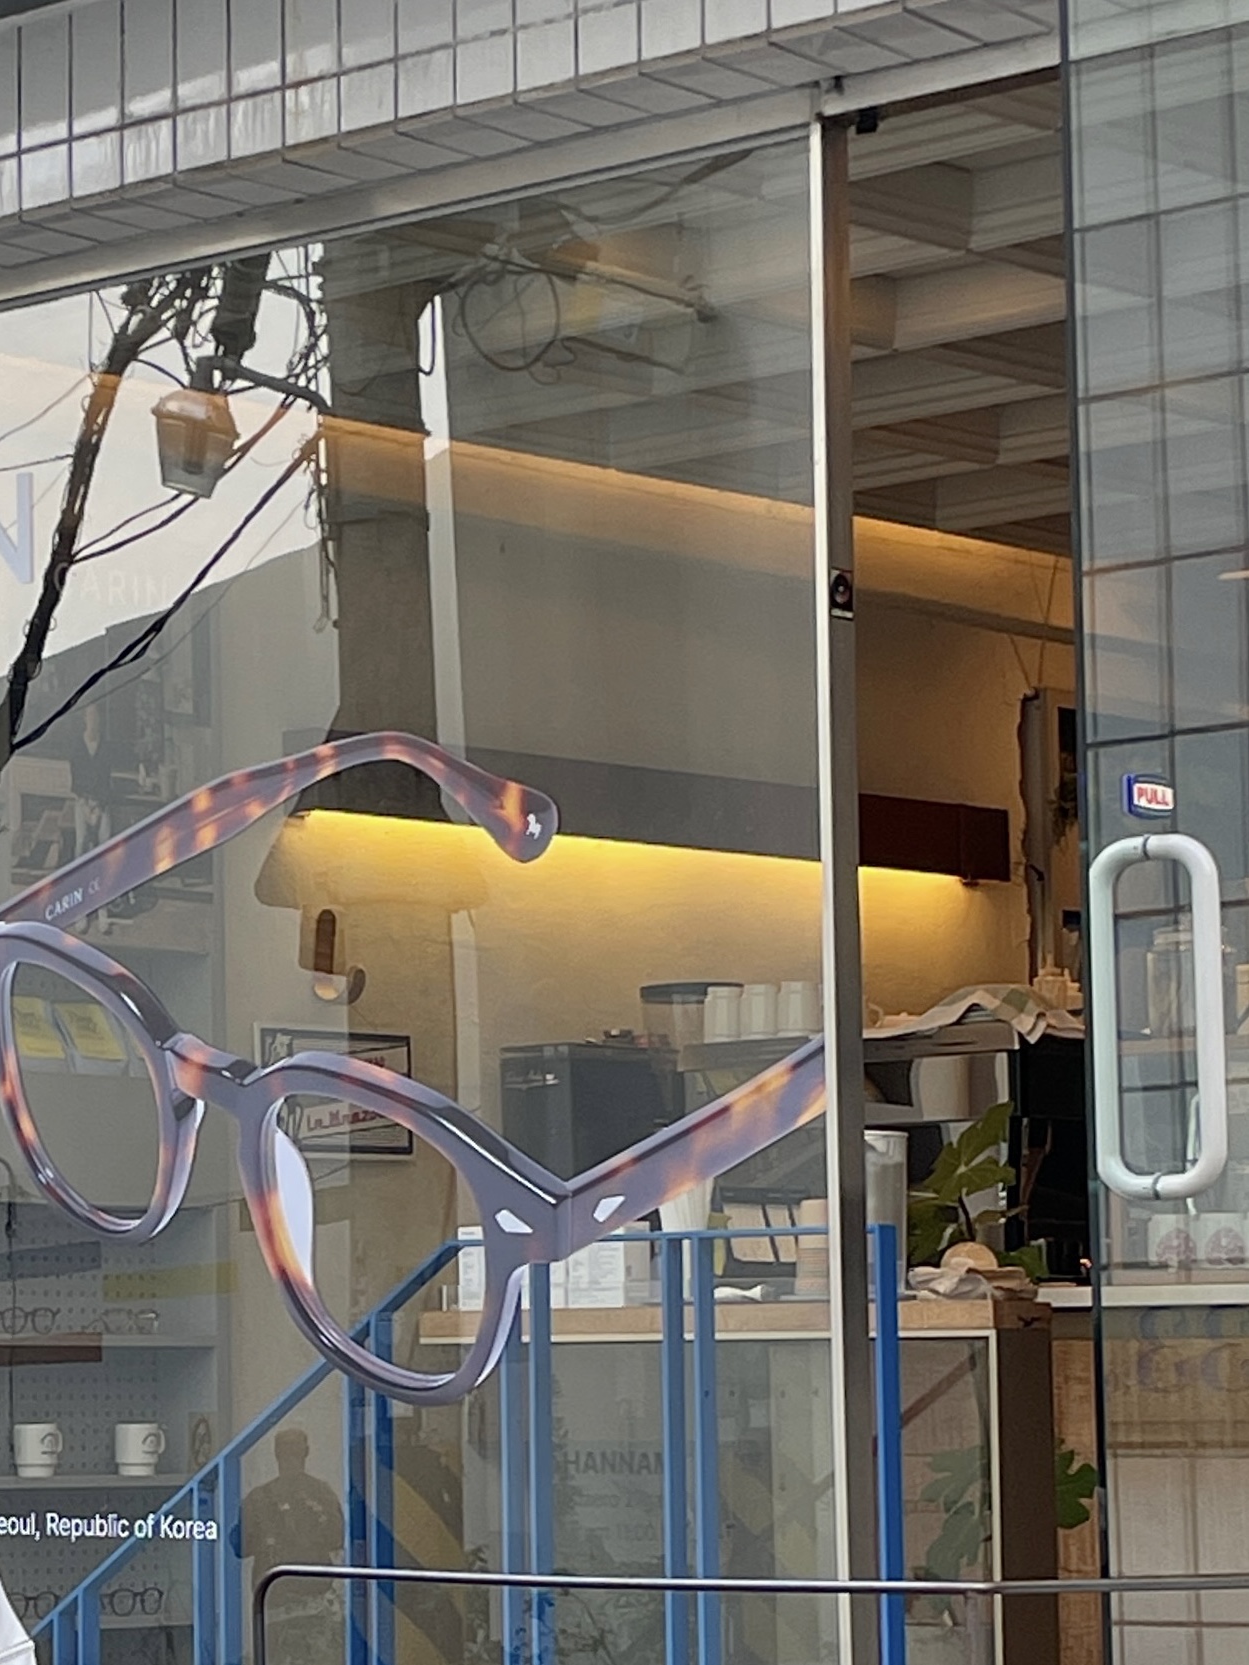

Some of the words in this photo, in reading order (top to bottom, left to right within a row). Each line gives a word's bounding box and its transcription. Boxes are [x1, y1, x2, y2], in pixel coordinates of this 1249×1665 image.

[1136, 786, 1170, 807] PULL
[45, 886, 84, 921] CARIN
[46, 1512, 129, 1542] Republic
[134, 1513, 155, 1539] of
[160, 1514, 218, 1540] Korea
